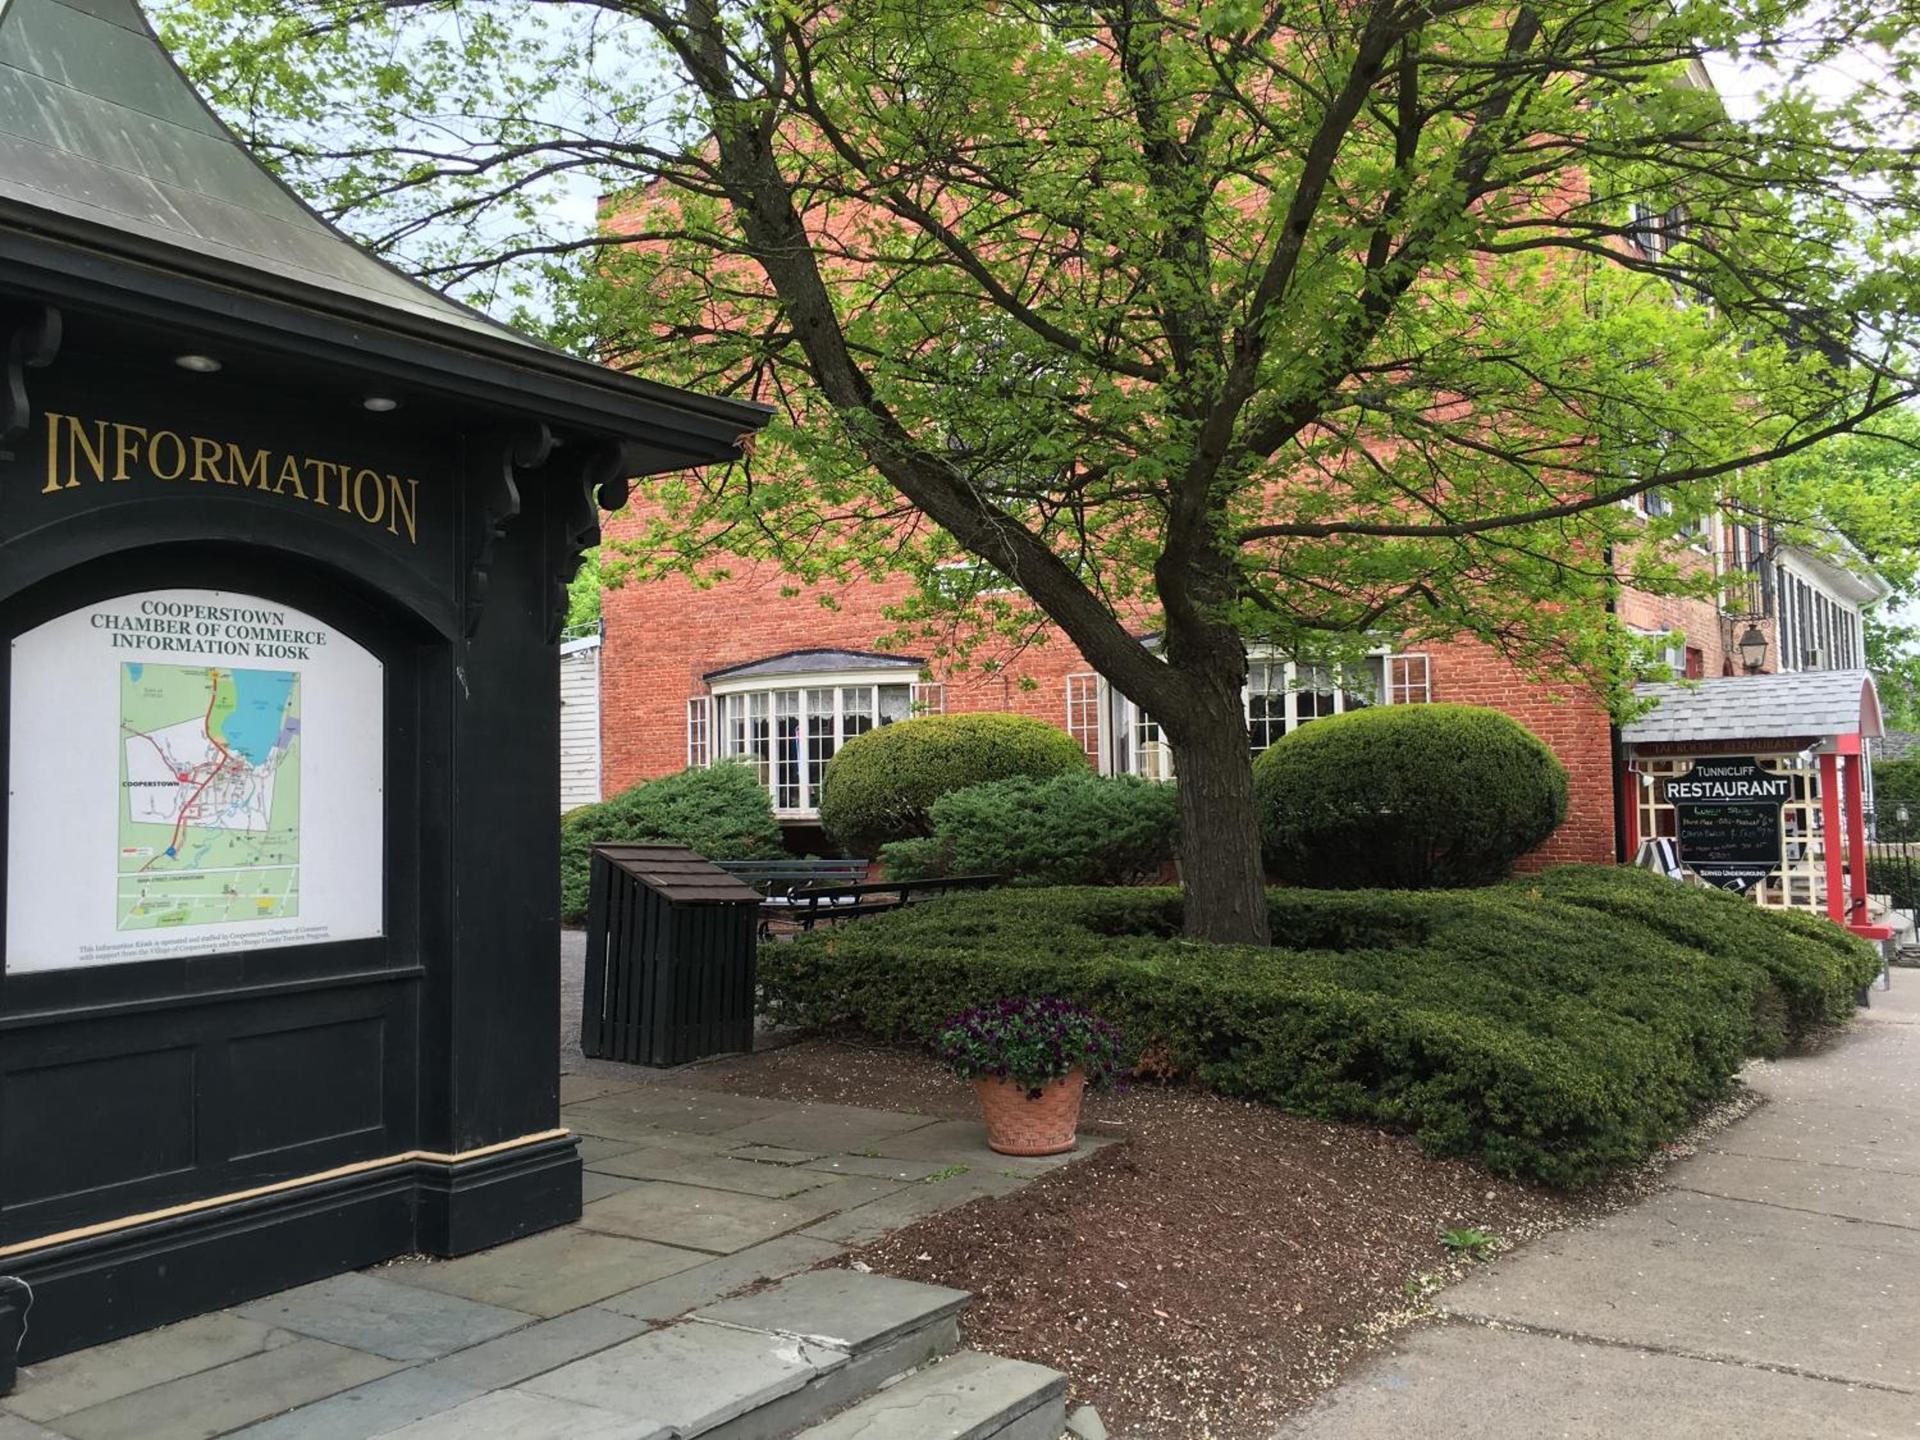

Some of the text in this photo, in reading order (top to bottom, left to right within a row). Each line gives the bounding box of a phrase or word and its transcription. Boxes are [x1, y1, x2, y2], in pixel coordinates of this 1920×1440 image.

[41, 411, 419, 544] INFORMATION
[141, 600, 285, 626] COOPERSTOWN
[90, 613, 327, 646] CHAMBER OF COMMERCE
[112, 633, 310, 660] INFORMATION KIOSK
[1696, 766, 1755, 777] TUNNICLIFF
[1667, 780, 1788, 798] RESTAURANT
